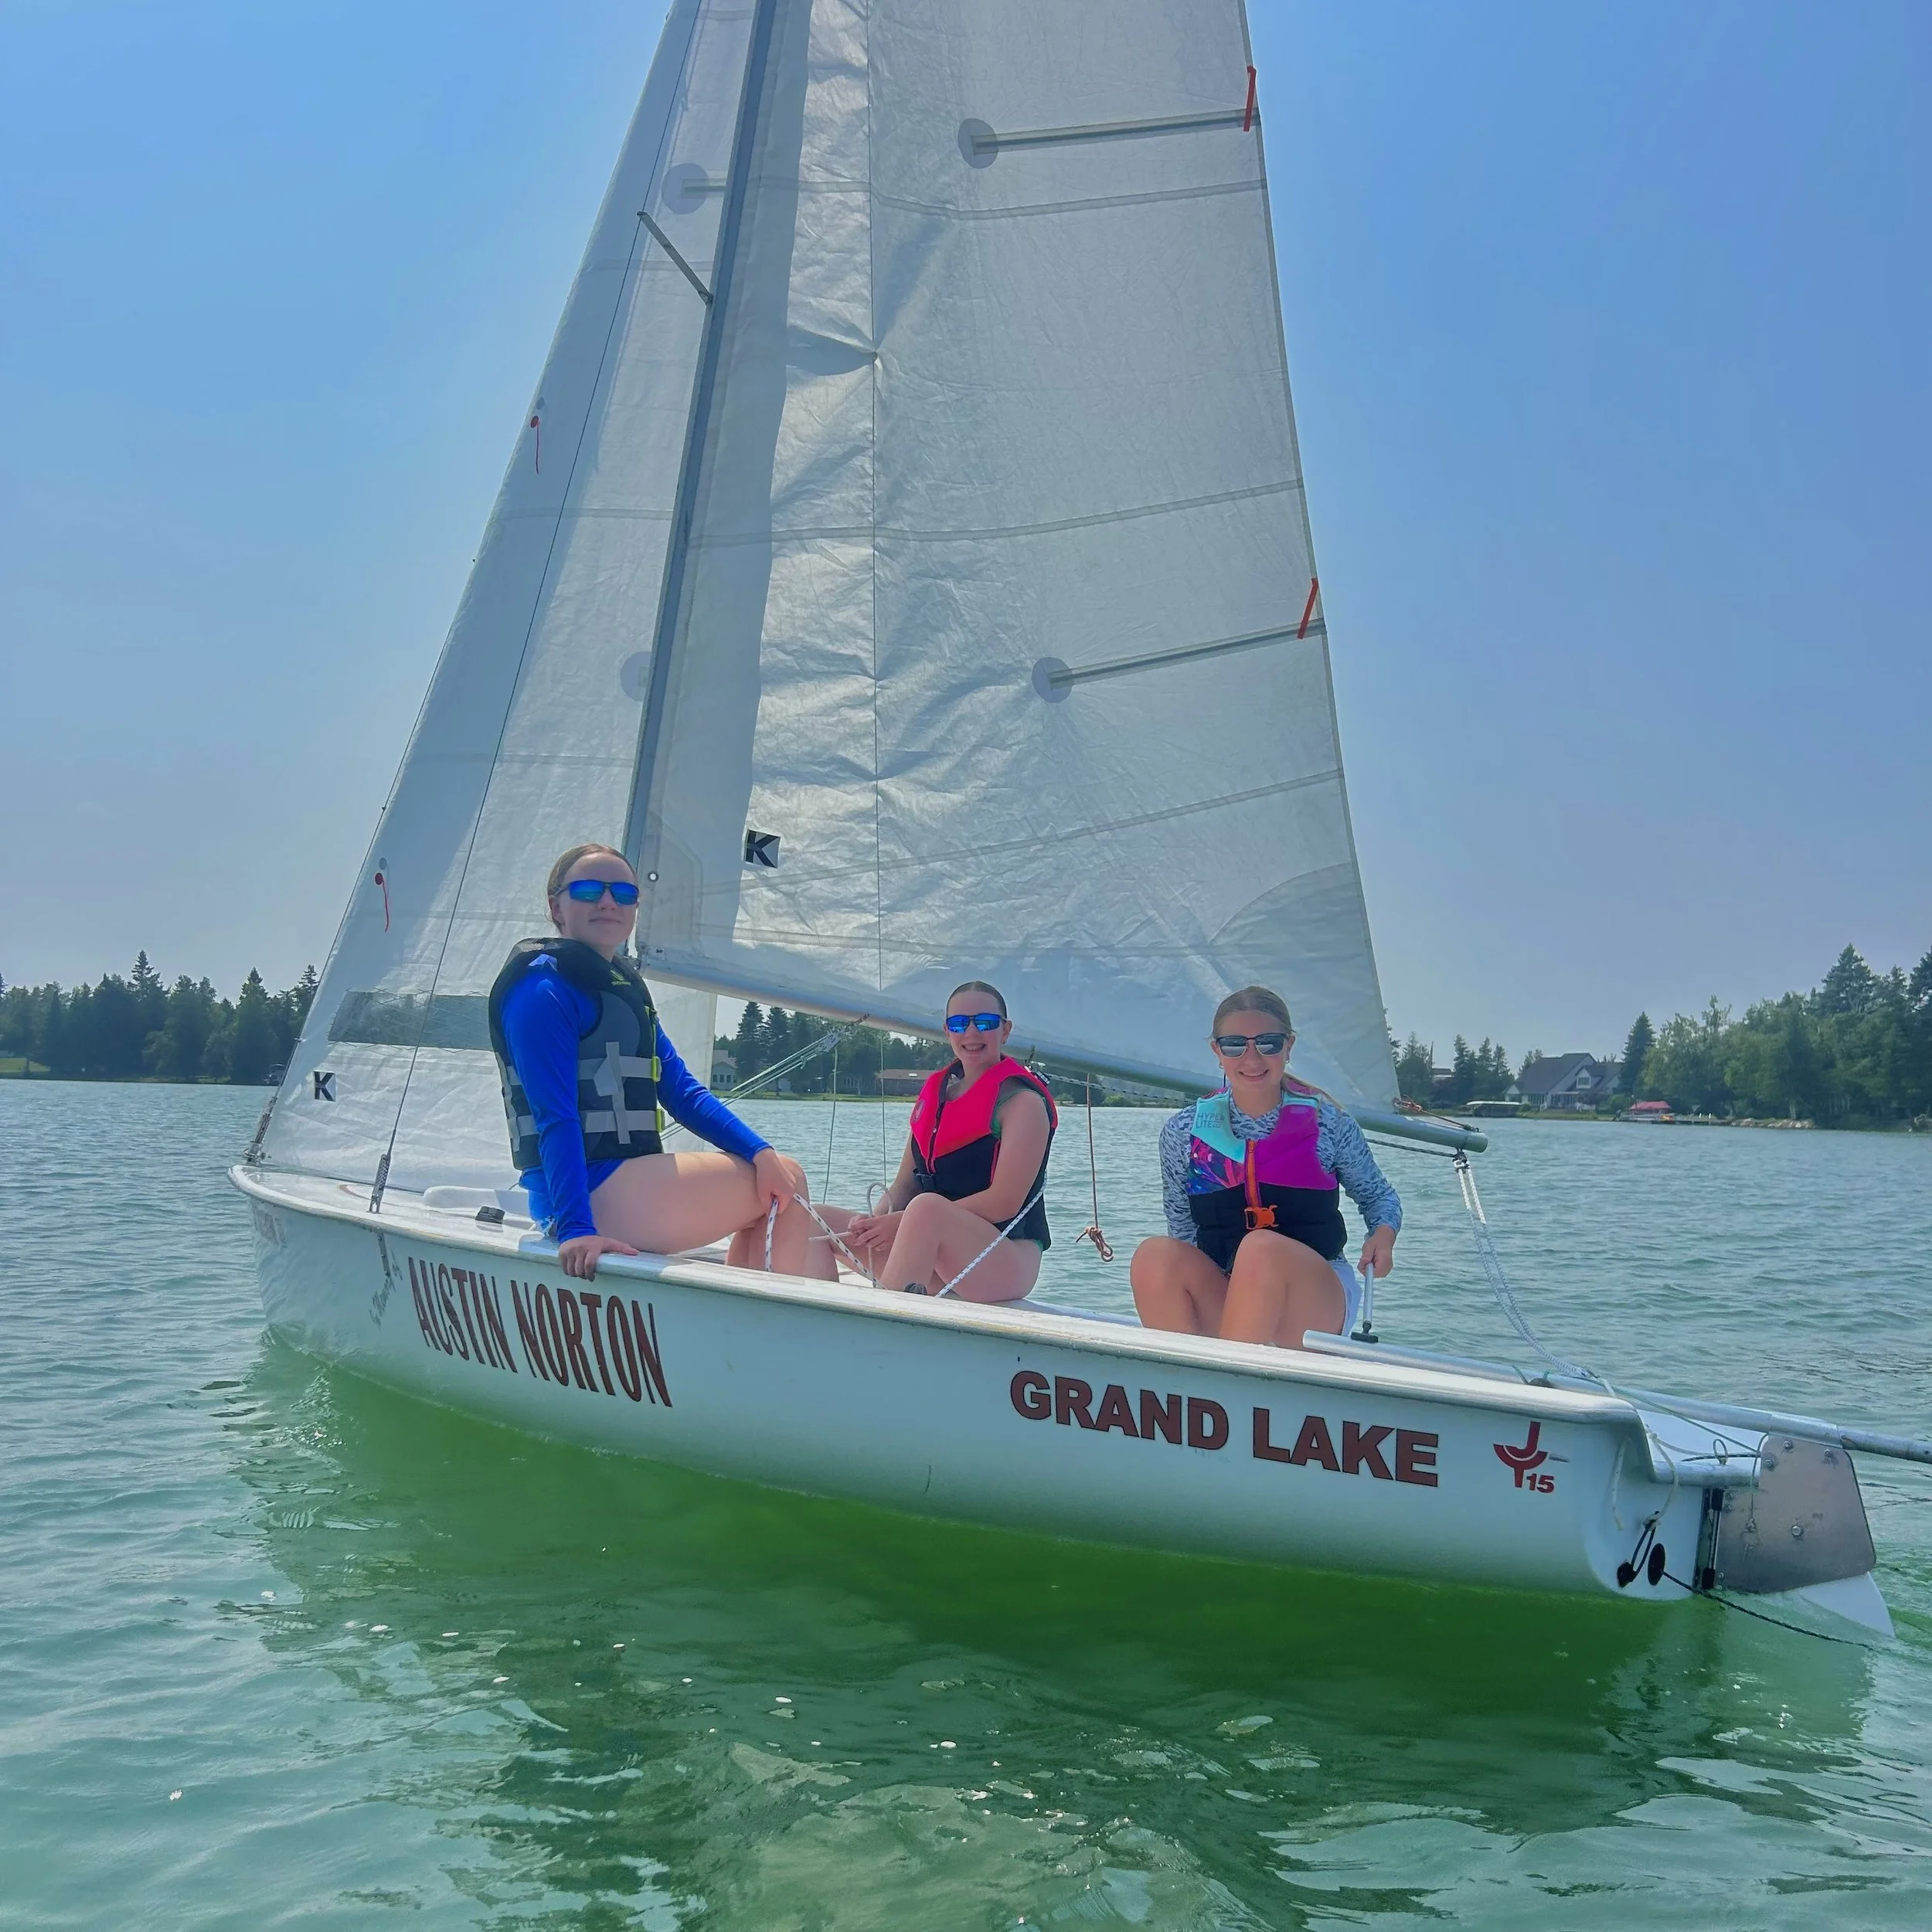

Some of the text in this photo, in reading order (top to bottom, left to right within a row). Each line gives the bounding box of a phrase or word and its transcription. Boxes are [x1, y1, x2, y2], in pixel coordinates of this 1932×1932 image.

[745, 829, 781, 869] K
[314, 1071, 335, 1102] K
[409, 1257, 672, 1407] AUSTIN NORTON
[1010, 1371, 1438, 1487] GRAND LAKE
[1526, 1473, 1555, 1493] 15
